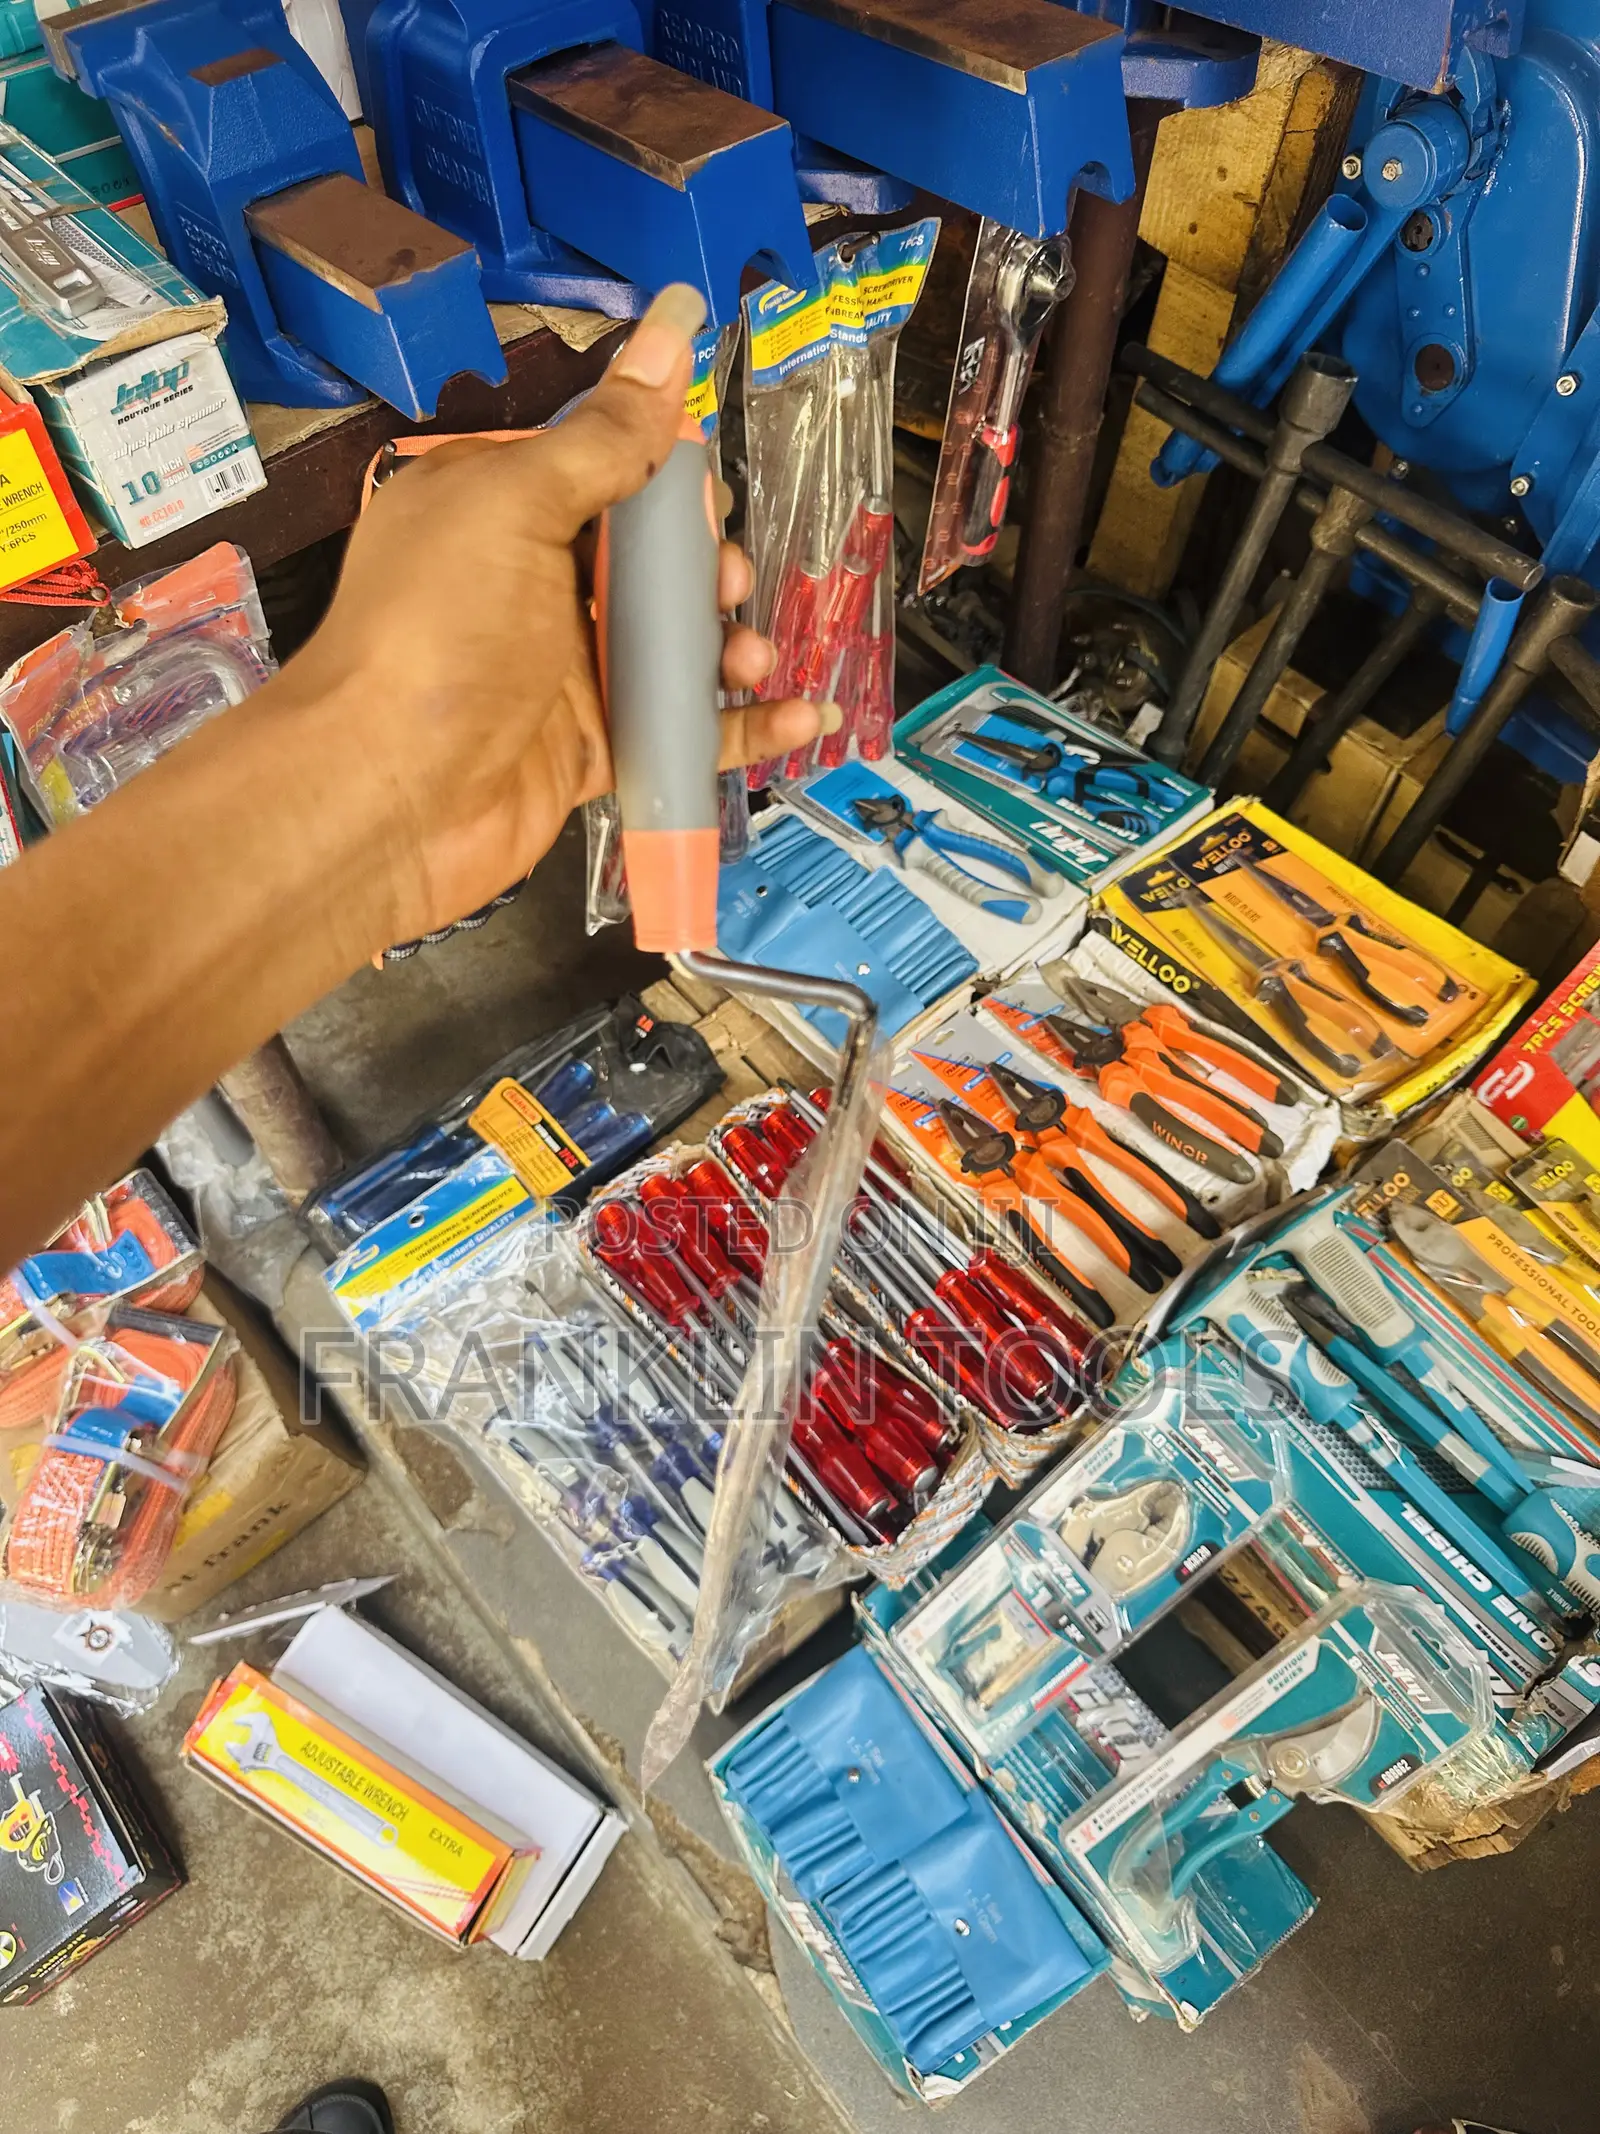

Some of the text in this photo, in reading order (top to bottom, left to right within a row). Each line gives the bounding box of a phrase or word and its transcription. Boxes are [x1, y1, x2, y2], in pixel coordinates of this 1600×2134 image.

[905, 234, 924, 249] PCS
[698, 344, 717, 364] PCS
[163, 384, 194, 404] SERIES
[3, 481, 45, 508] WRENCH
[121, 457, 184, 506] 10 INCH
[1110, 921, 1191, 994] WELLOO
[475, 1211, 517, 1245] QUALITY
[1486, 1232, 1570, 1310] PROFESSIONAL
[1401, 1502, 1494, 1593] CHISEL
[1266, 1650, 1309, 1686] BOUTIQUE
[1273, 1665, 1304, 1693] SERIES
[299, 1739, 410, 1823] ADJUSTABLE WRENCH
[428, 1827, 465, 1858] EXTRA
